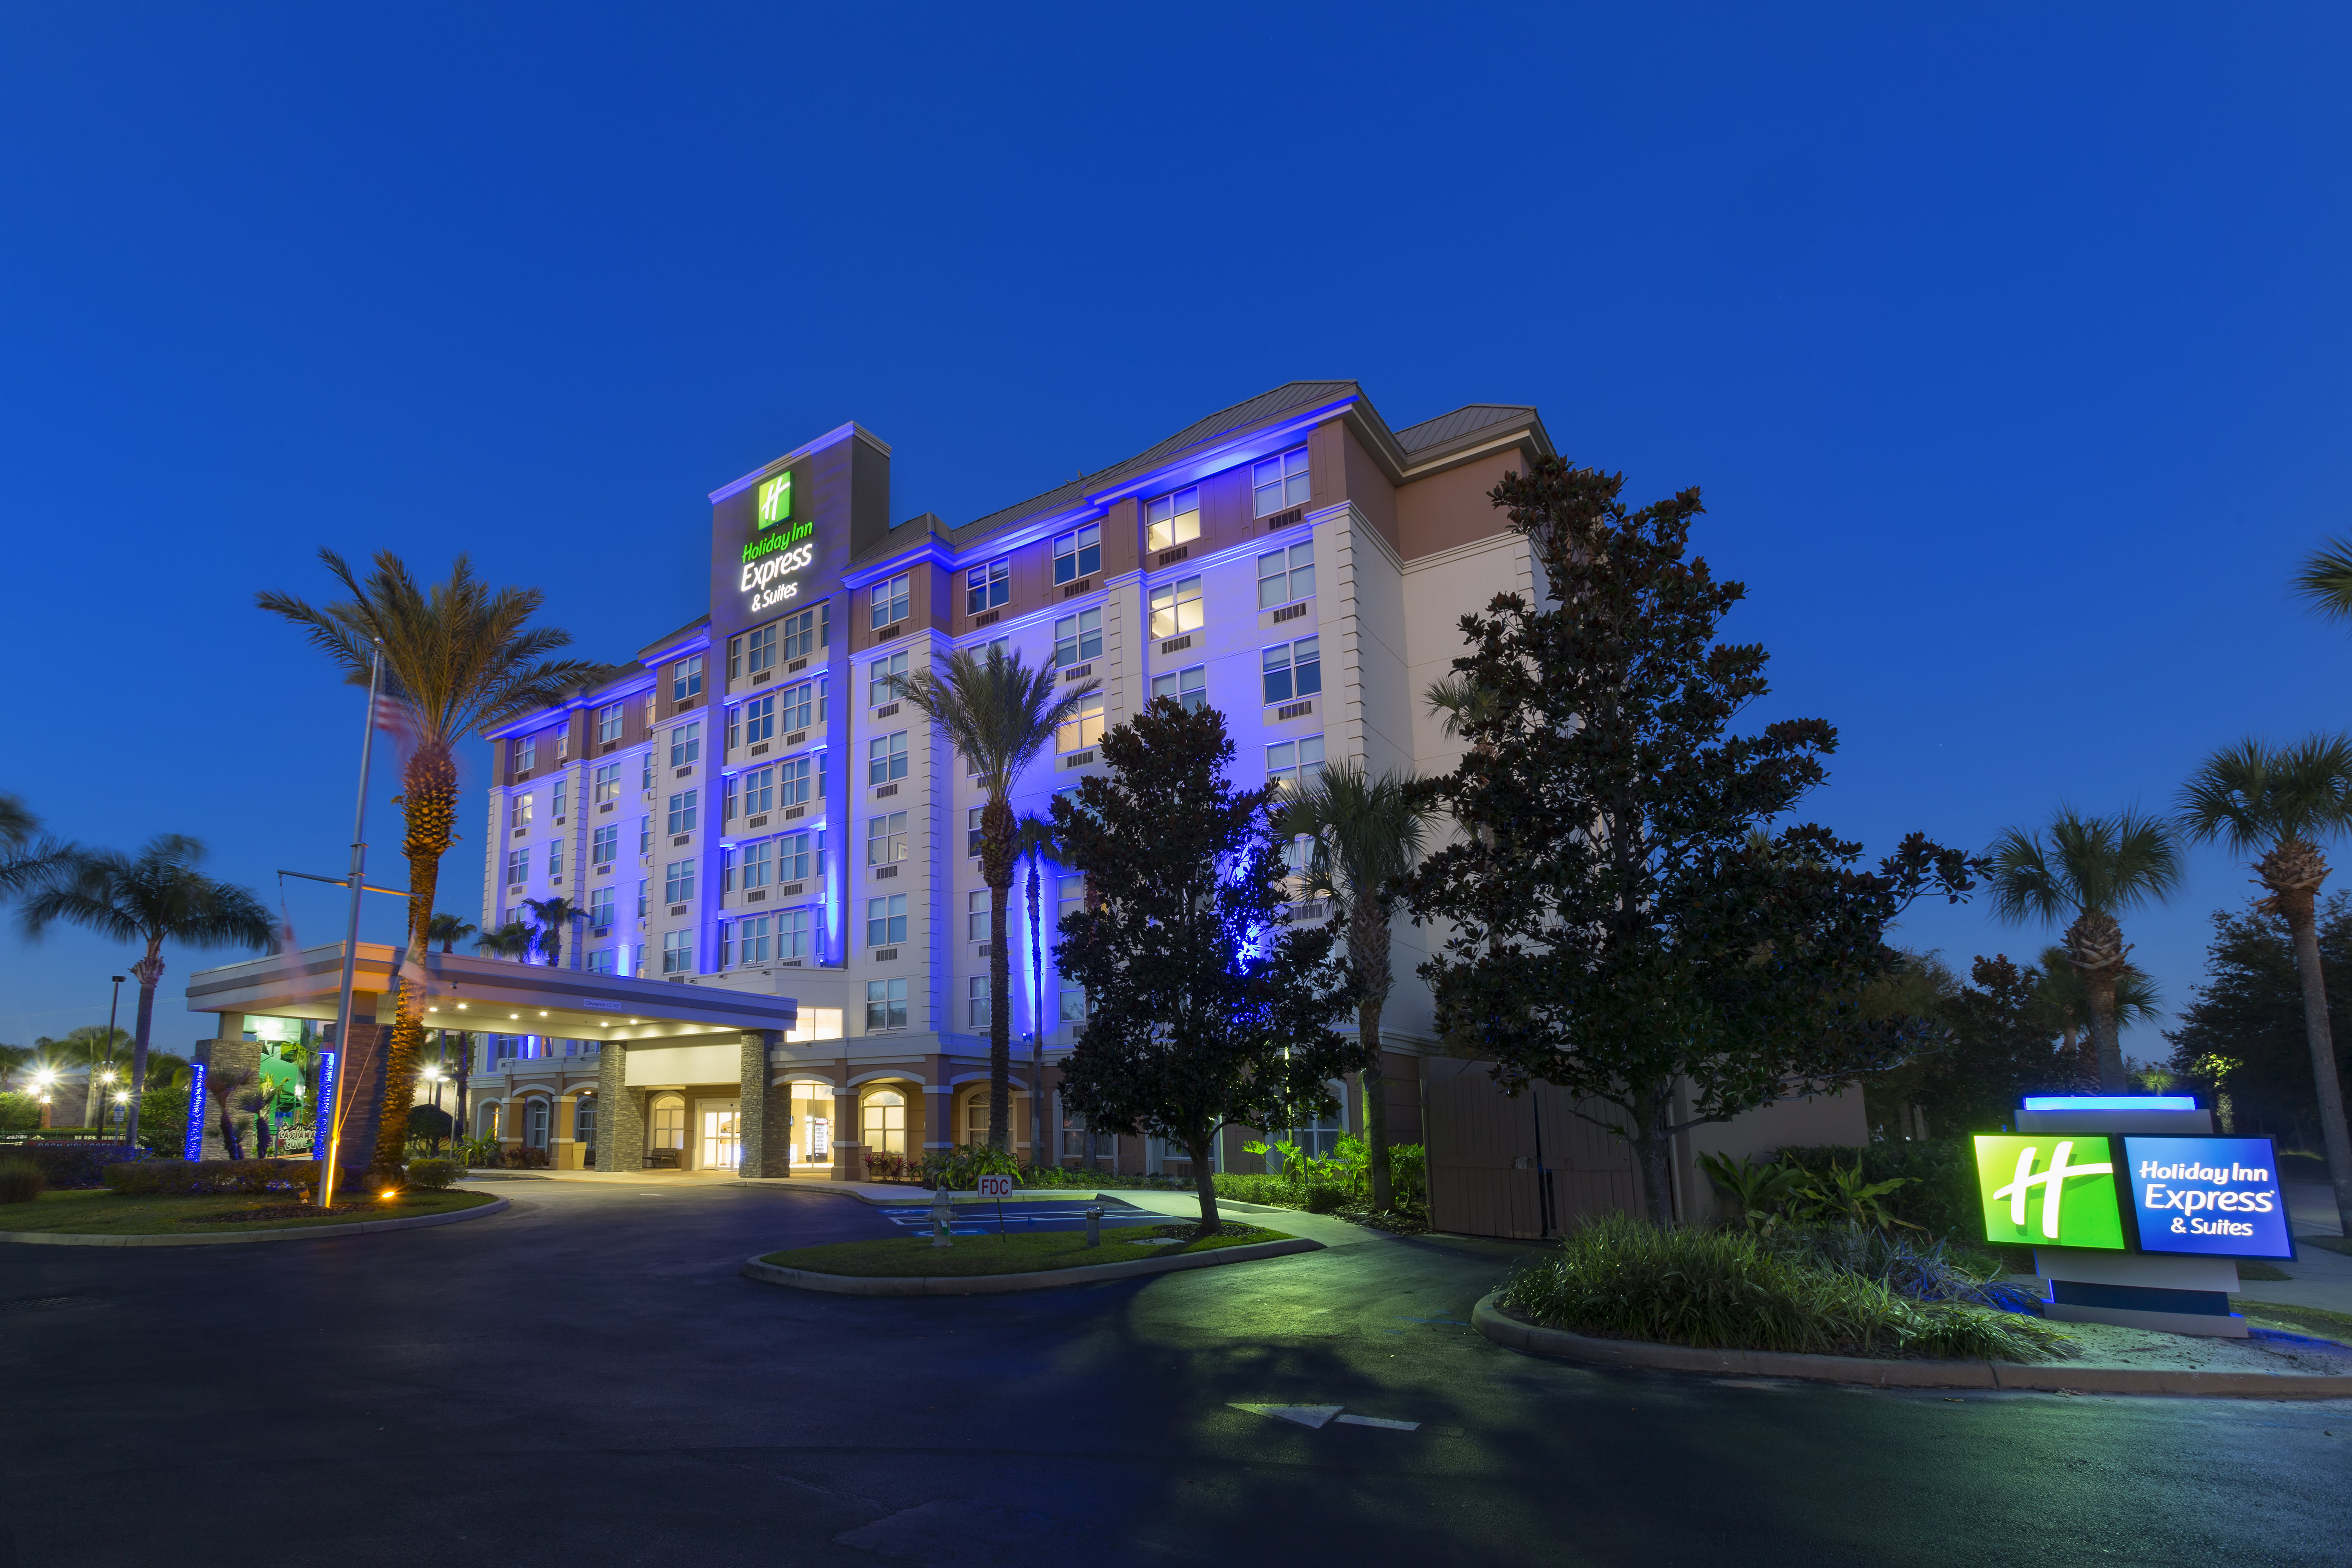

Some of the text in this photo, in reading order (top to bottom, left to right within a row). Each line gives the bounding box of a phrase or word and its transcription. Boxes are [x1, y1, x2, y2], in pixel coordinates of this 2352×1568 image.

[742, 522, 813, 564] Holiday Inn
[741, 543, 813, 592] Express
[752, 582, 797, 612] & Suites
[278, 1129, 316, 1140] CASTAWA
[284, 1137, 309, 1151] COVE
[2139, 1160, 2268, 1185] Holiday Inn
[982, 1179, 1009, 1195] FDC
[2145, 1183, 2273, 1216] Express
[2170, 1217, 2254, 1236] & Suites
